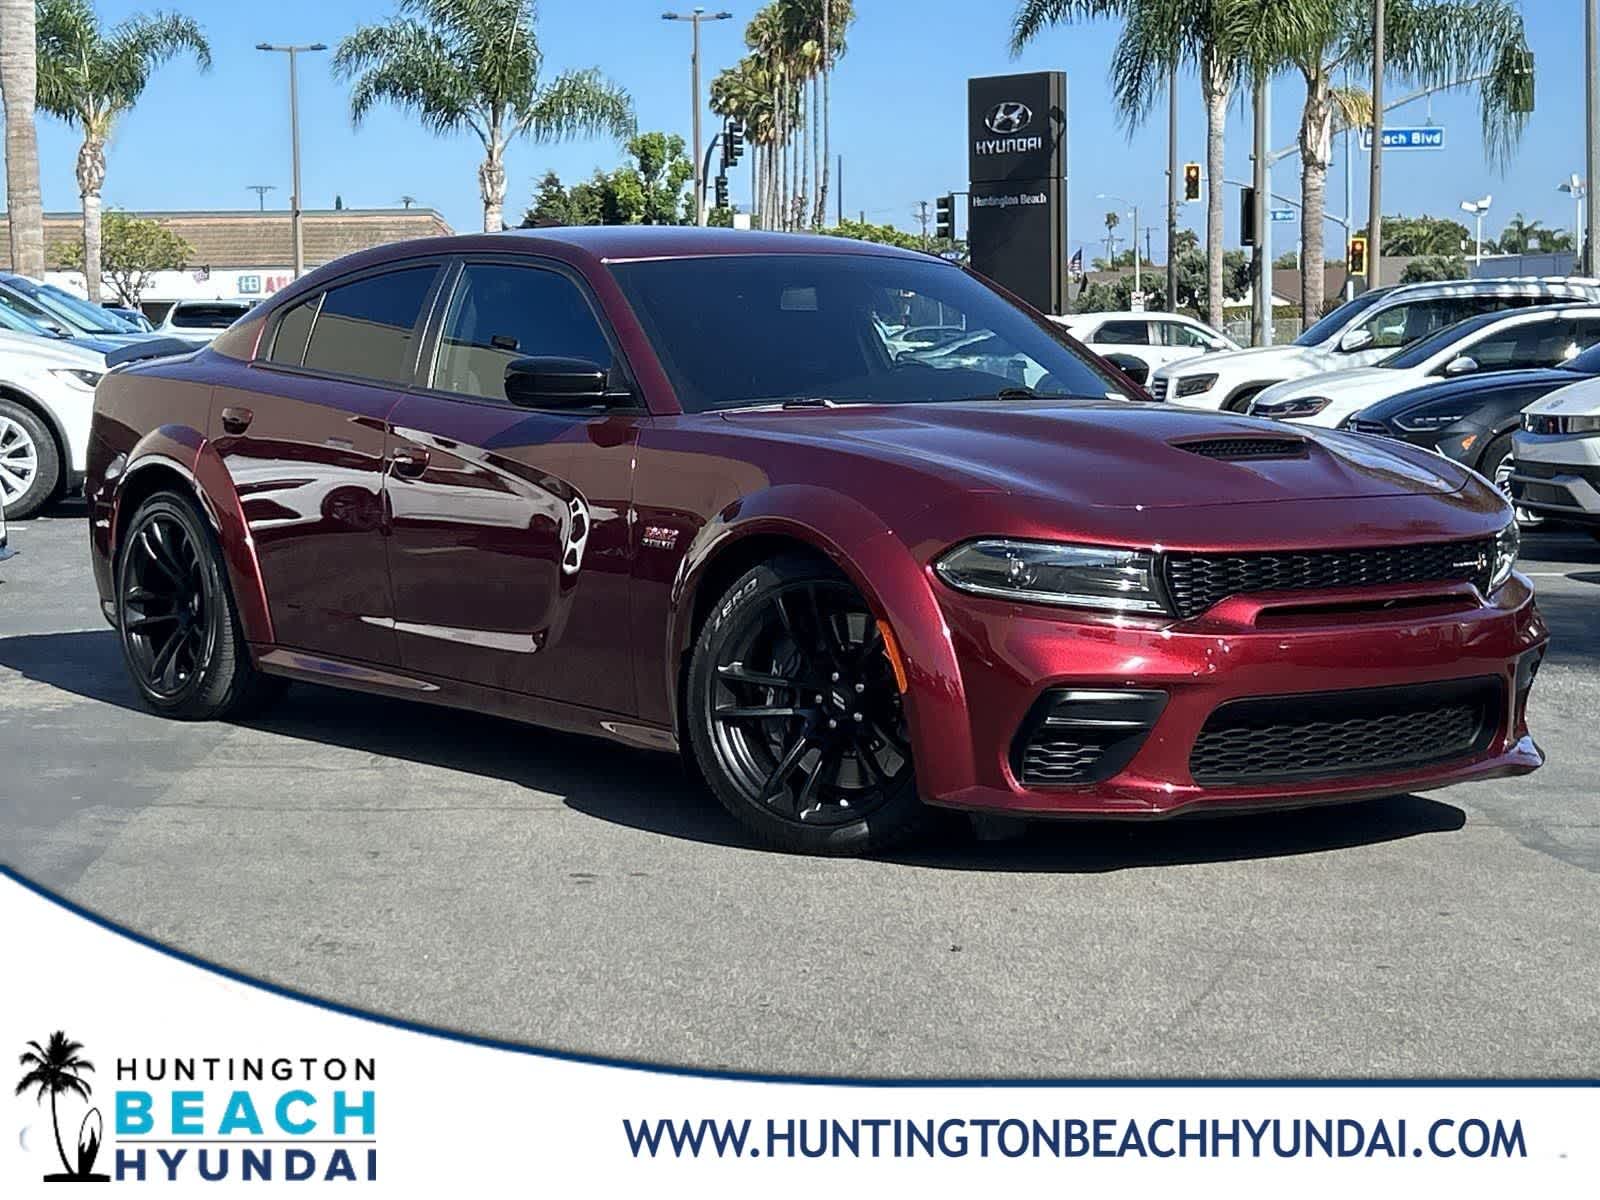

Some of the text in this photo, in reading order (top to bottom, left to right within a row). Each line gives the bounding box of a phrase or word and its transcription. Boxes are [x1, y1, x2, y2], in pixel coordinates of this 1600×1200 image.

[976, 137, 1042, 154] HYUNDAI
[1365, 132, 1441, 145] Bach Blvd
[973, 192, 1047, 208] Huntington Beach
